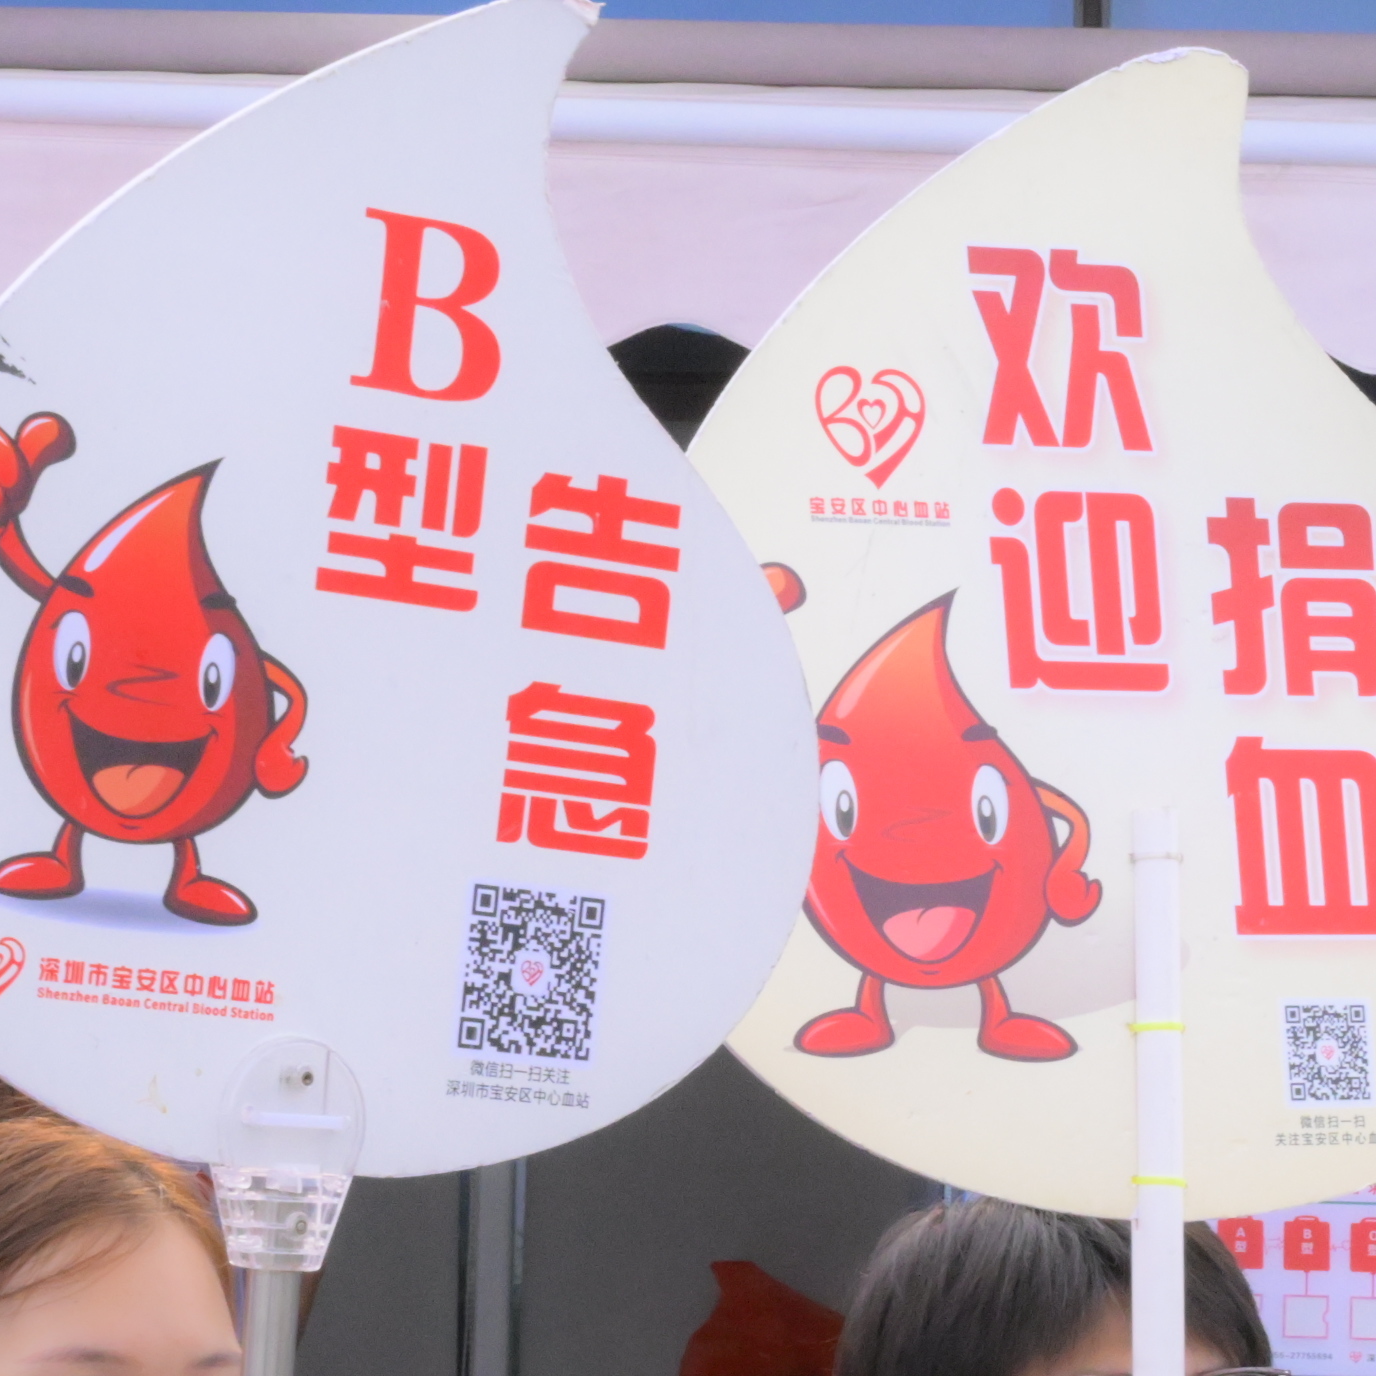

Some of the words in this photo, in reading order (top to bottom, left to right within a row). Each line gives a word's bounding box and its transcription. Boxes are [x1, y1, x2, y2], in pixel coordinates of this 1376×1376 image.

[967, 245, 1169, 692] 欢迎
[810, 497, 950, 519] 宝安区中心血站
[496, 472, 681, 860] 告急
[38, 957, 275, 1004] 深圳市宝安区中心血站
[37, 986, 100, 1005] Shenzhen
[102, 993, 141, 1009] Baoan
[143, 998, 189, 1014] Central
[192, 1003, 228, 1018] Blood
[230, 1005, 275, 1022] Station
[470, 1060, 571, 1085] 微信扫一扫关注
[446, 1080, 591, 1109] 深圳市宝安区中心血站
[1300, 1115, 1366, 1129] 微信扫一扫
